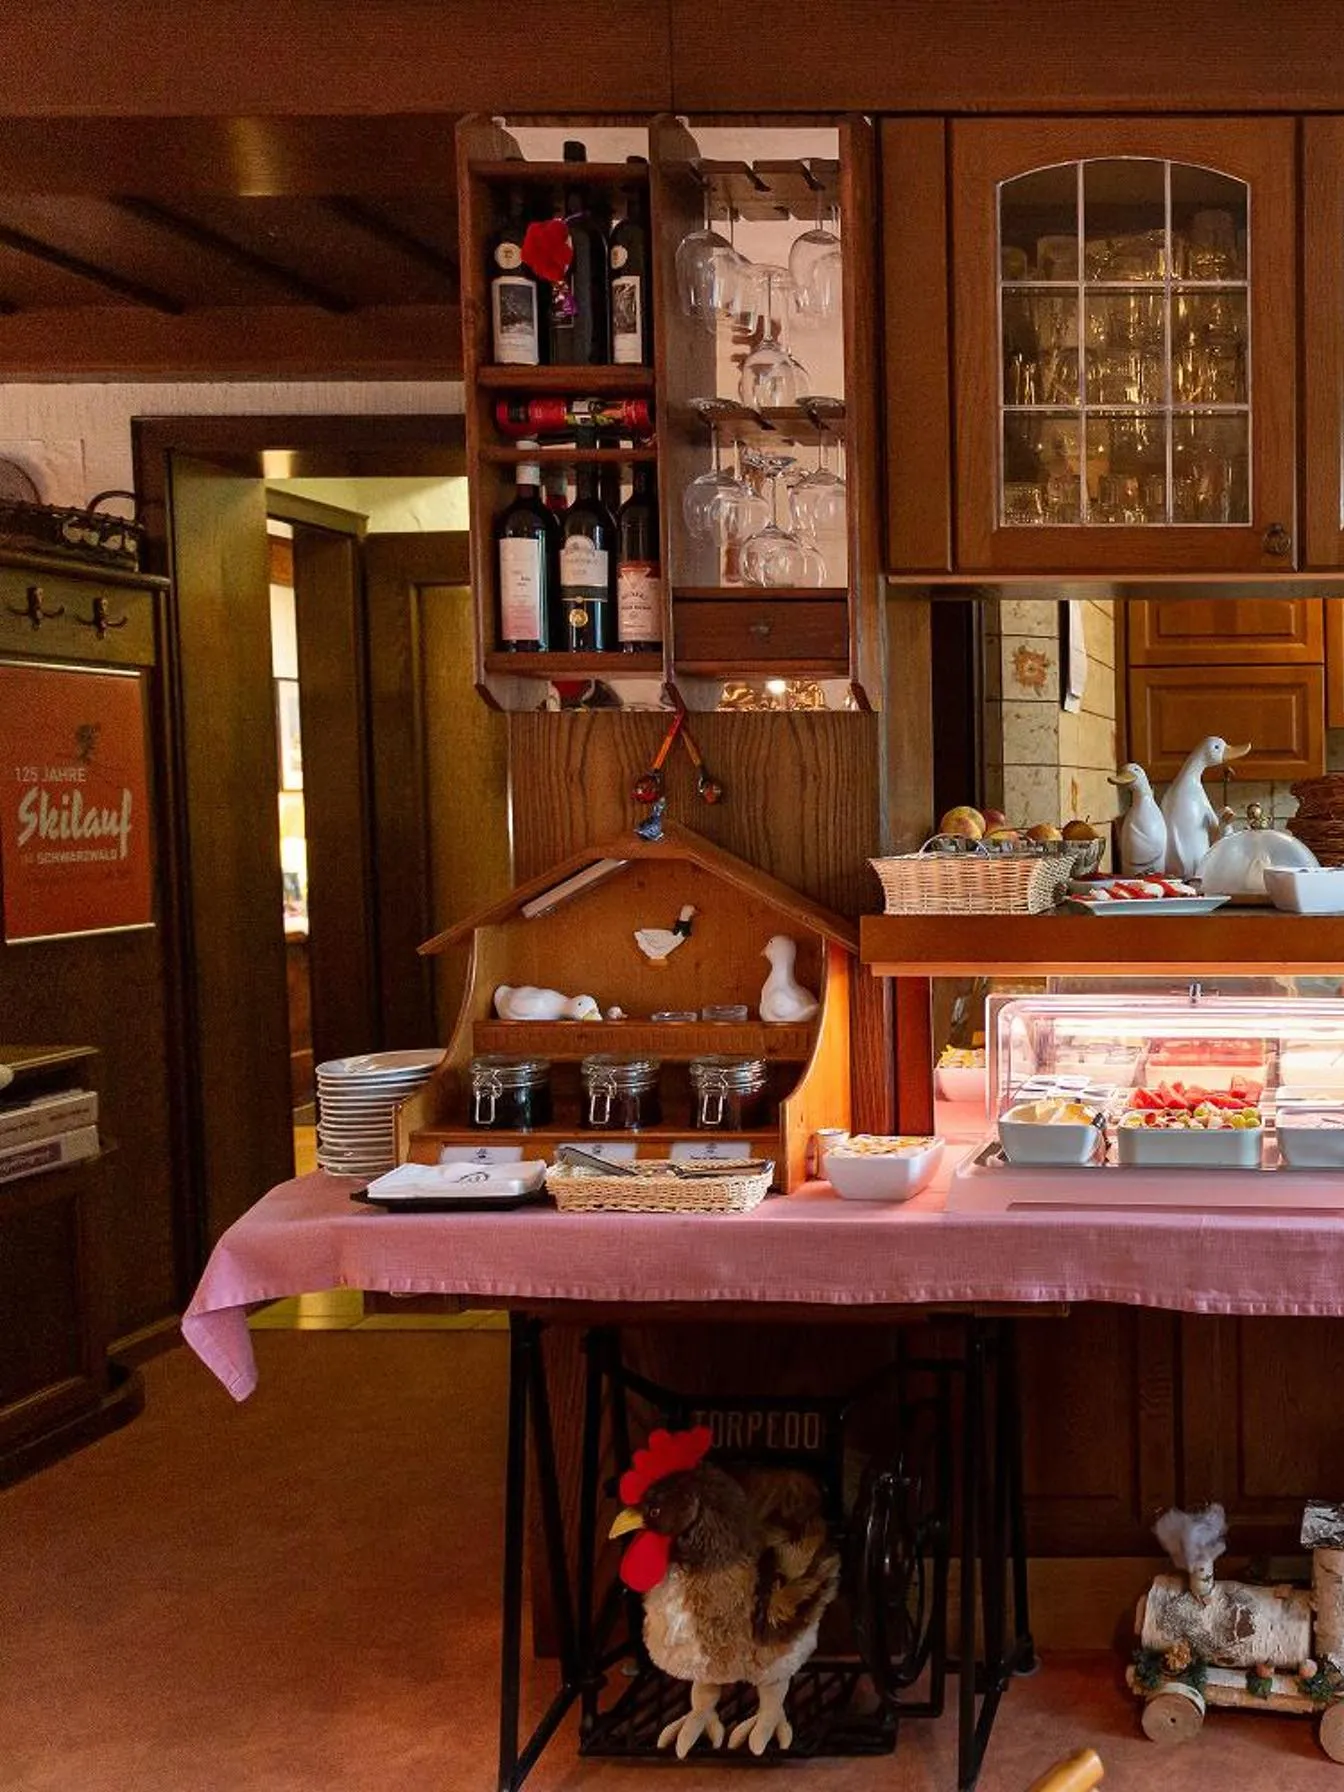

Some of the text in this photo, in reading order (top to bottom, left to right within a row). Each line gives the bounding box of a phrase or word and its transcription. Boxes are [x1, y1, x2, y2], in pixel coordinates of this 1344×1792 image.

[15, 766, 87, 783] 125 JAHRE
[18, 787, 132, 859] Skilauf
